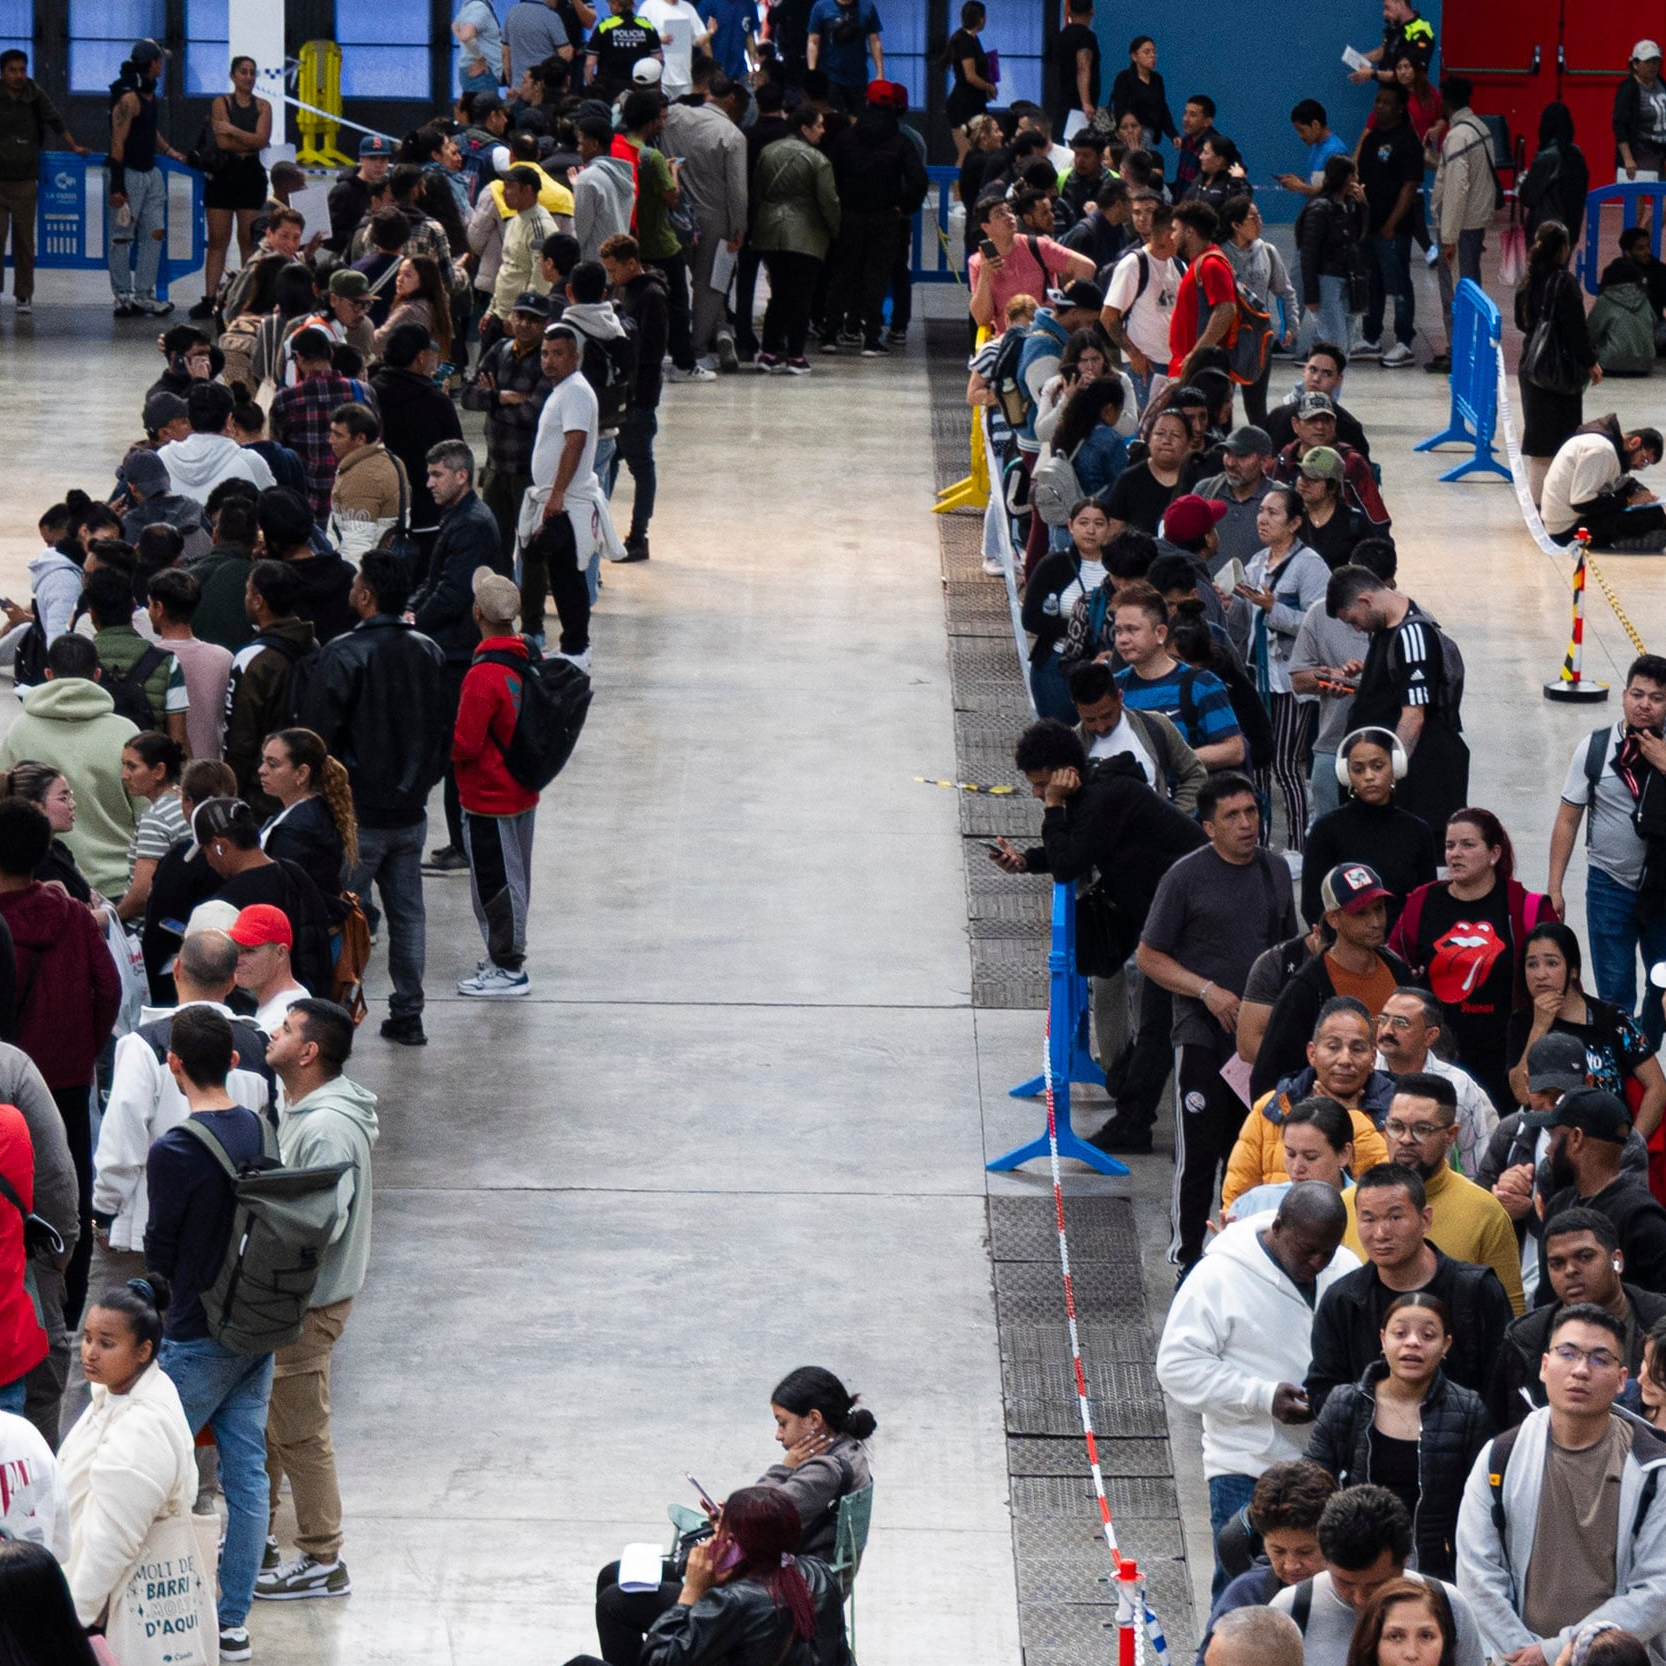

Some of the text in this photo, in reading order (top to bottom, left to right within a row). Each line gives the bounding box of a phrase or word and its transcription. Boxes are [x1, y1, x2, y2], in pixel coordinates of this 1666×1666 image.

[134, 1556, 194, 1581] MOLT DE
[146, 1577, 190, 1600] BARRI
